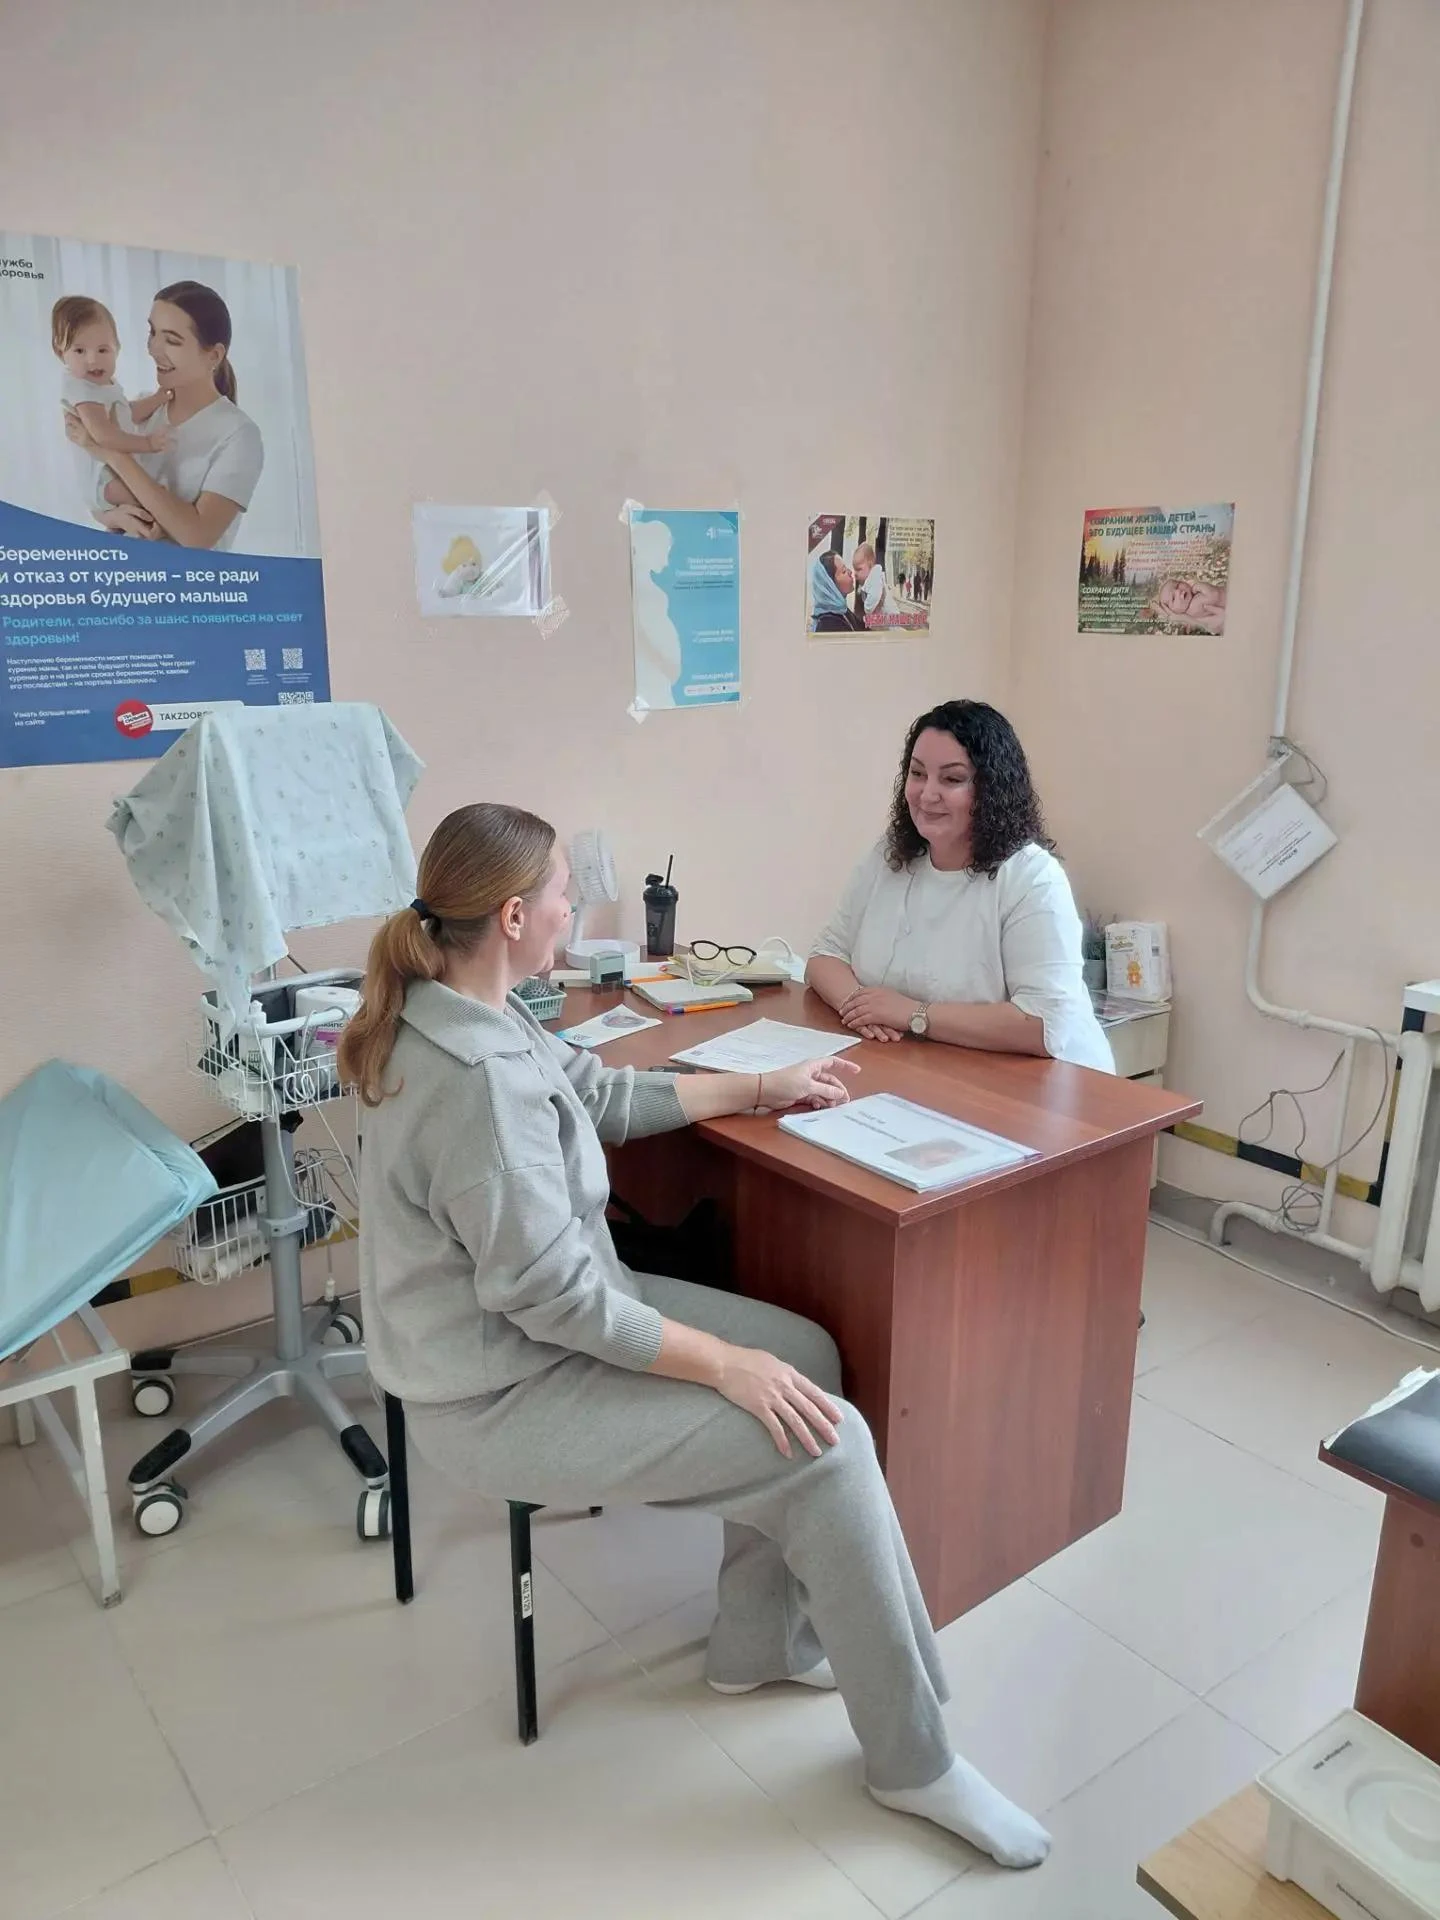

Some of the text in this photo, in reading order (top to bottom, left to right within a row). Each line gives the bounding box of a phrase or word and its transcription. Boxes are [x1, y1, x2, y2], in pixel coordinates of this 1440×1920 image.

[0, 258, 33, 268] ужба
[0, 269, 44, 279] оровья
[1168, 510, 1196, 524] ДЕТЕЙ
[1106, 526, 1144, 537] БУДУЩЕЕ
[1146, 522, 1177, 535] НАШЕЙ
[1179, 523, 1216, 534] СТРАНЫ
[13, 571, 65, 583] отказ
[69, 571, 89, 583] от
[94, 570, 167, 586] курения
[185, 570, 215, 582] все
[219, 570, 260, 585] ради
[0, 589, 248, 609] здоровья будущего малыша
[2, 613, 304, 628] Родители, спасибо за шанс появиться на свет
[5, 632, 80, 647] здоровым!
[160, 711, 213, 721] TAKZDOR
